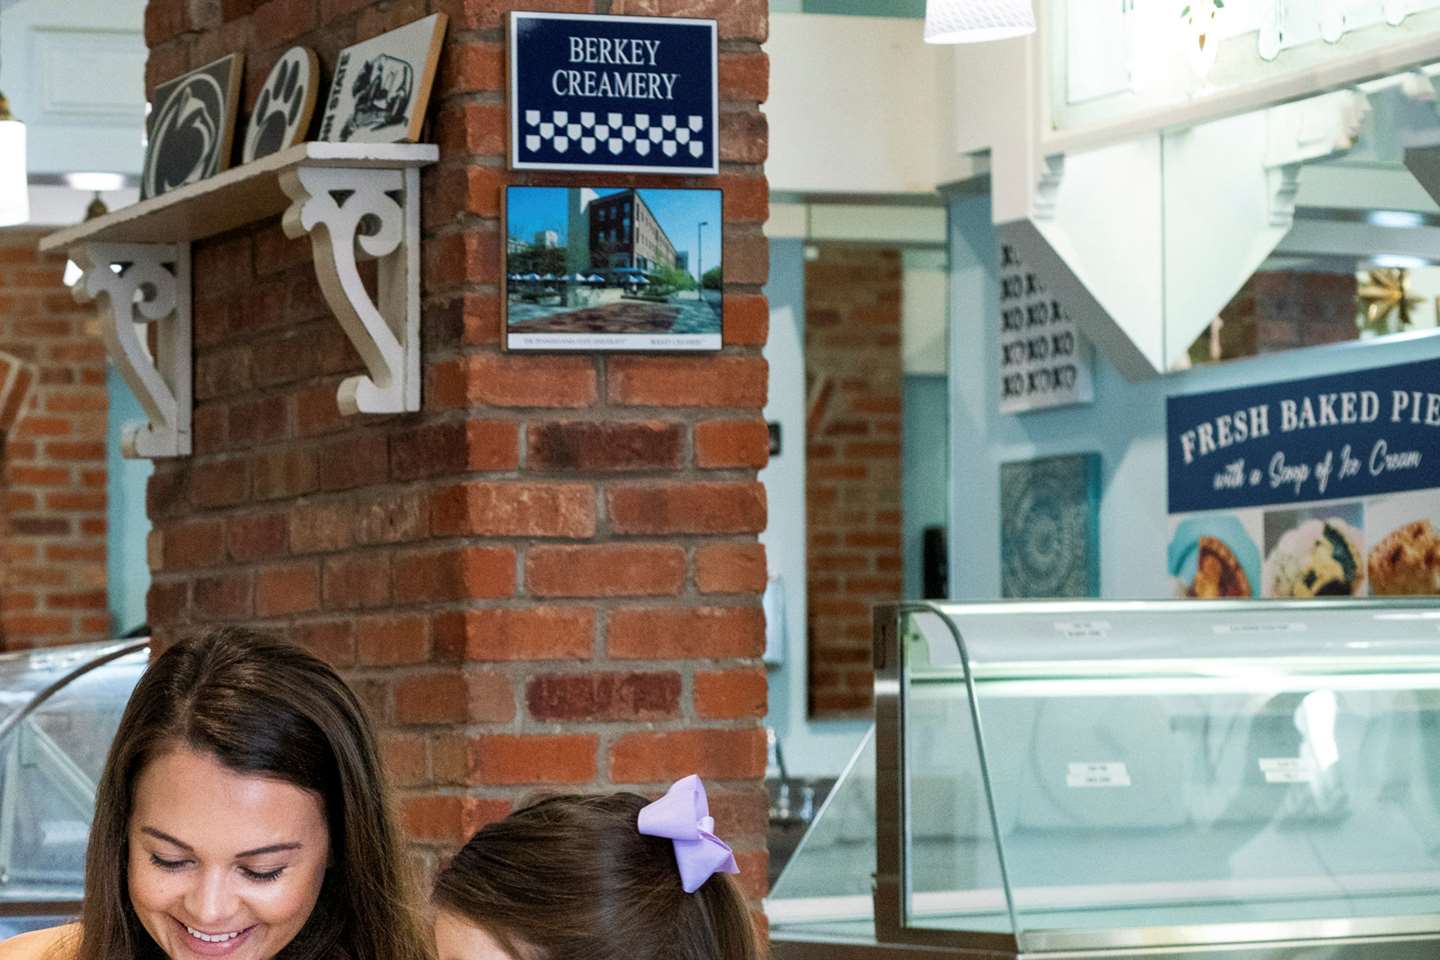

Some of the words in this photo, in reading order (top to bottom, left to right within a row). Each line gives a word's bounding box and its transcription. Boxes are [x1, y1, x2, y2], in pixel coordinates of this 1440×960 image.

[568, 36, 661, 66] BERKEY
[329, 52, 351, 110] STATE
[551, 68, 679, 100] CREAMERY
[1179, 404, 1271, 465] FRESH
[1280, 390, 1380, 433] BAKED
[1213, 457, 1245, 491] with
[1249, 468, 1263, 487] a
[1315, 449, 1333, 494] of
[1338, 444, 1361, 480] Ice
[1368, 438, 1423, 478] Cream
